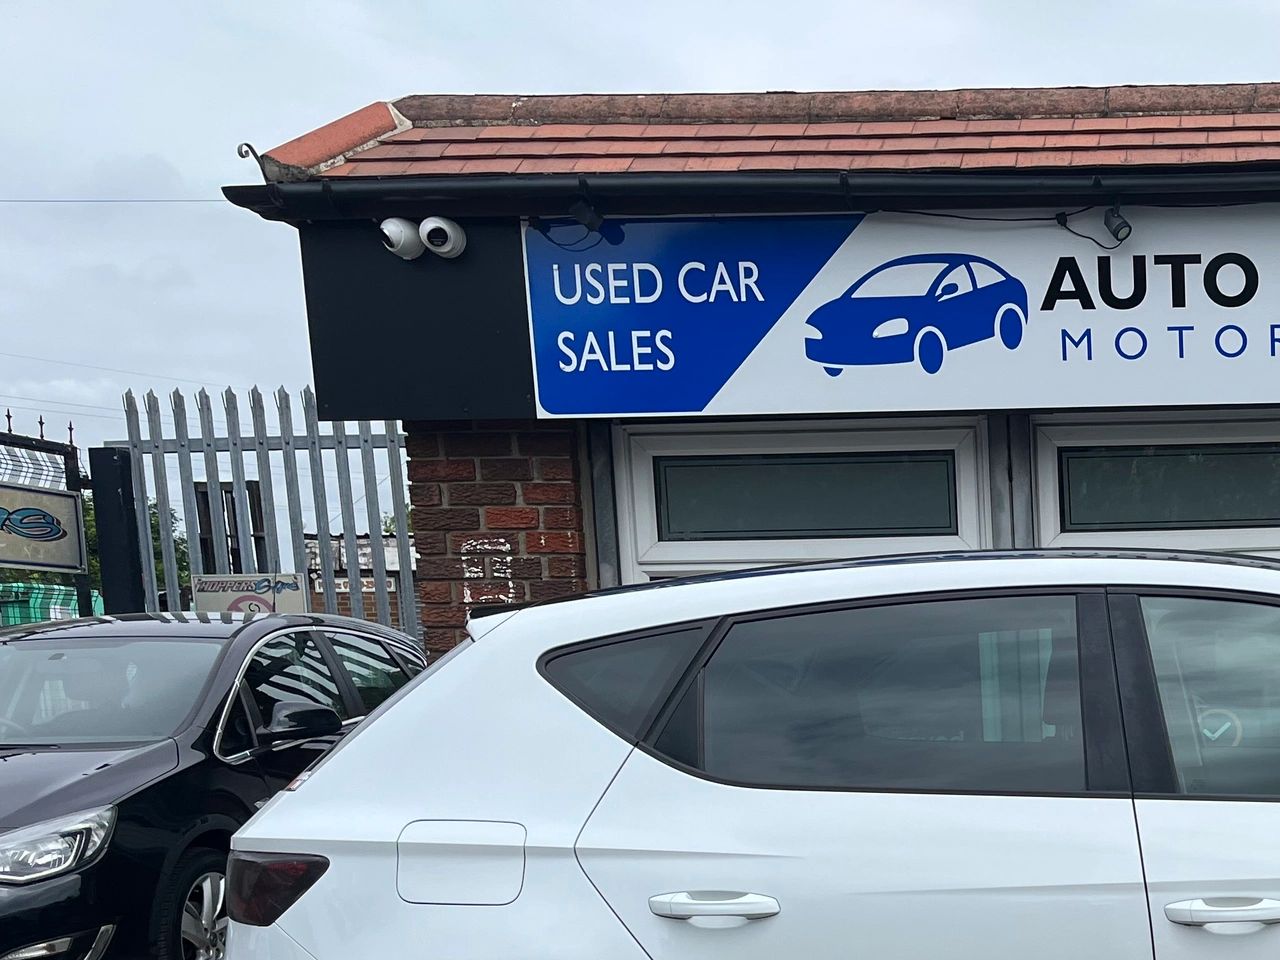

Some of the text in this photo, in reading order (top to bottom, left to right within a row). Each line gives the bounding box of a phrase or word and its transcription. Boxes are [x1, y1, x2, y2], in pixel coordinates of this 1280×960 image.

[552, 261, 765, 305] USED CAR
[1040, 252, 1258, 311] AUTO
[557, 329, 675, 373] SALES
